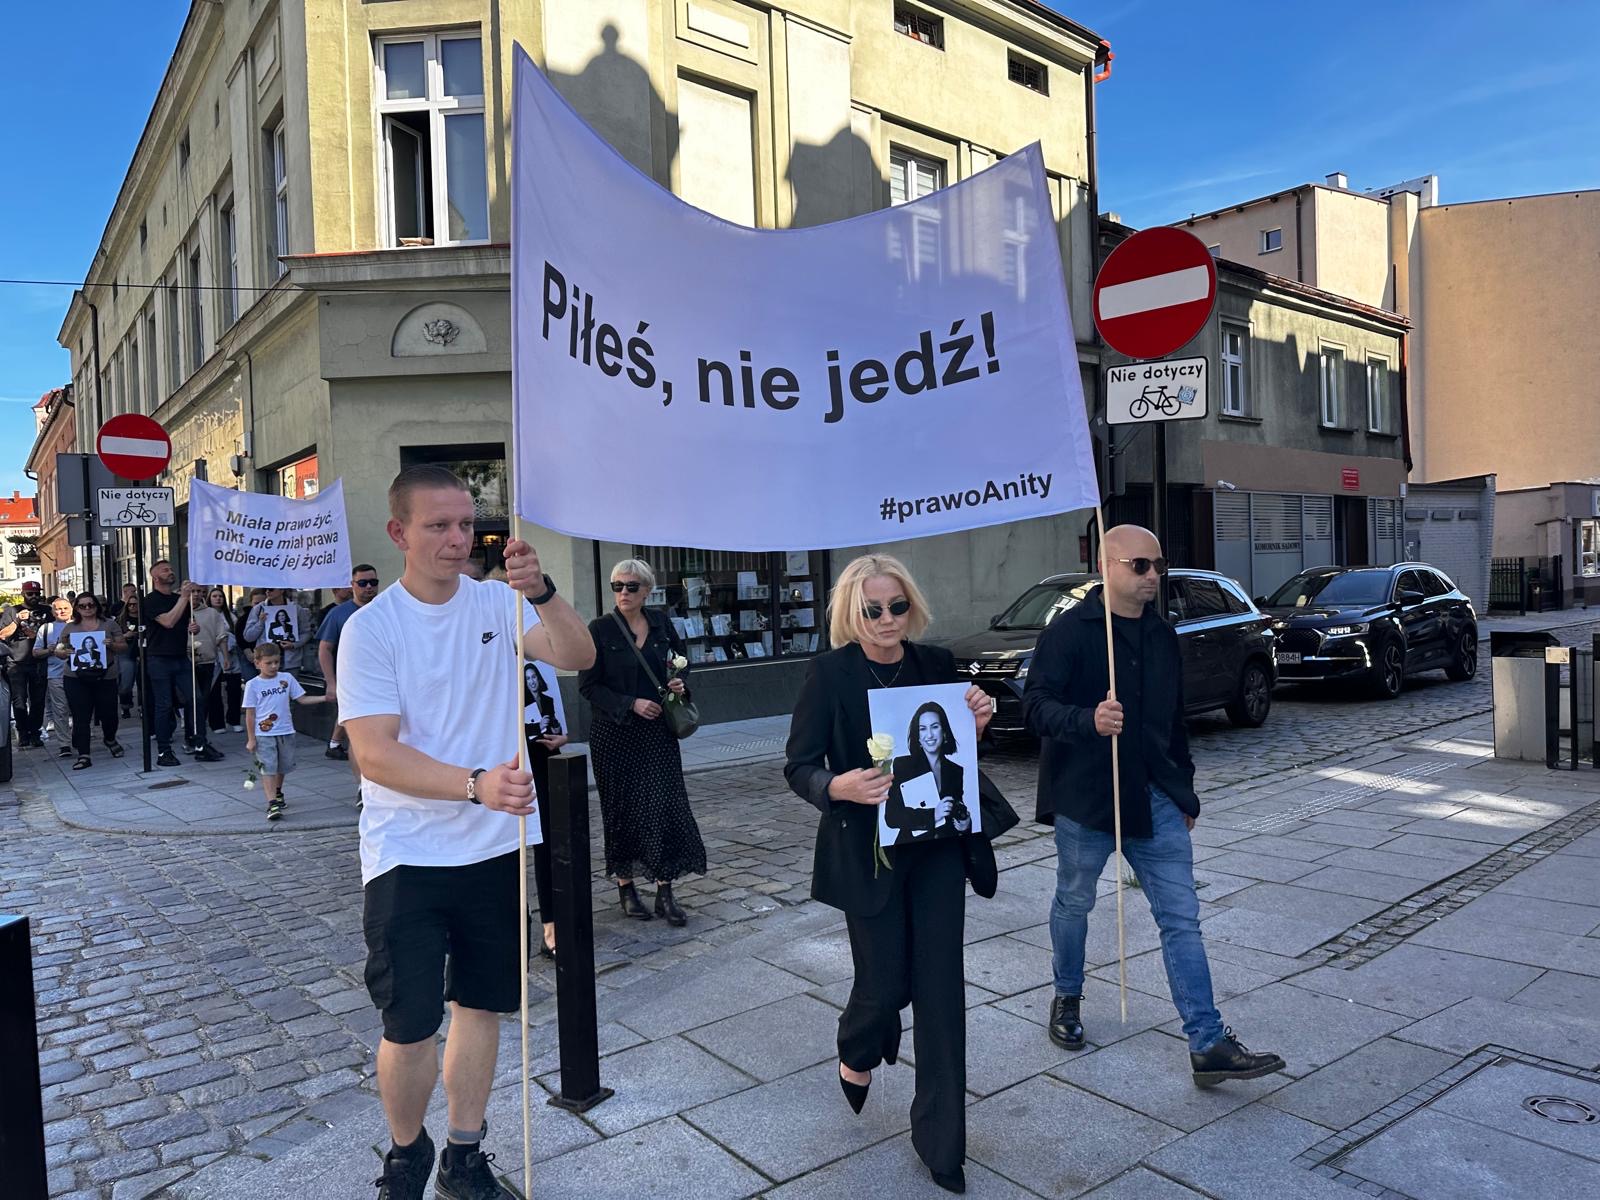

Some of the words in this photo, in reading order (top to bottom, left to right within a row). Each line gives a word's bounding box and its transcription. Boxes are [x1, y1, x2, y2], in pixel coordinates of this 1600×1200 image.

[542, 260, 674, 407] Piłeś,
[697, 350, 800, 410] nie
[824, 311, 1001, 424] jedź!
[1111, 369, 1136, 383] Nie
[1143, 364, 1203, 381] dotyczy
[101, 490, 121, 500] Nie
[126, 490, 169, 501] dotyczy
[879, 471, 1054, 524] #prawoAnity
[226, 510, 272, 531] Miała
[275, 518, 311, 534] prawo
[215, 528, 245, 544] nikt
[249, 536, 274, 549] nie
[277, 535, 304, 550] miał
[306, 531, 339, 551] prawa
[214, 548, 280, 568] odbierać
[280, 554, 301, 571] jej
[301, 549, 336, 569] życia!
